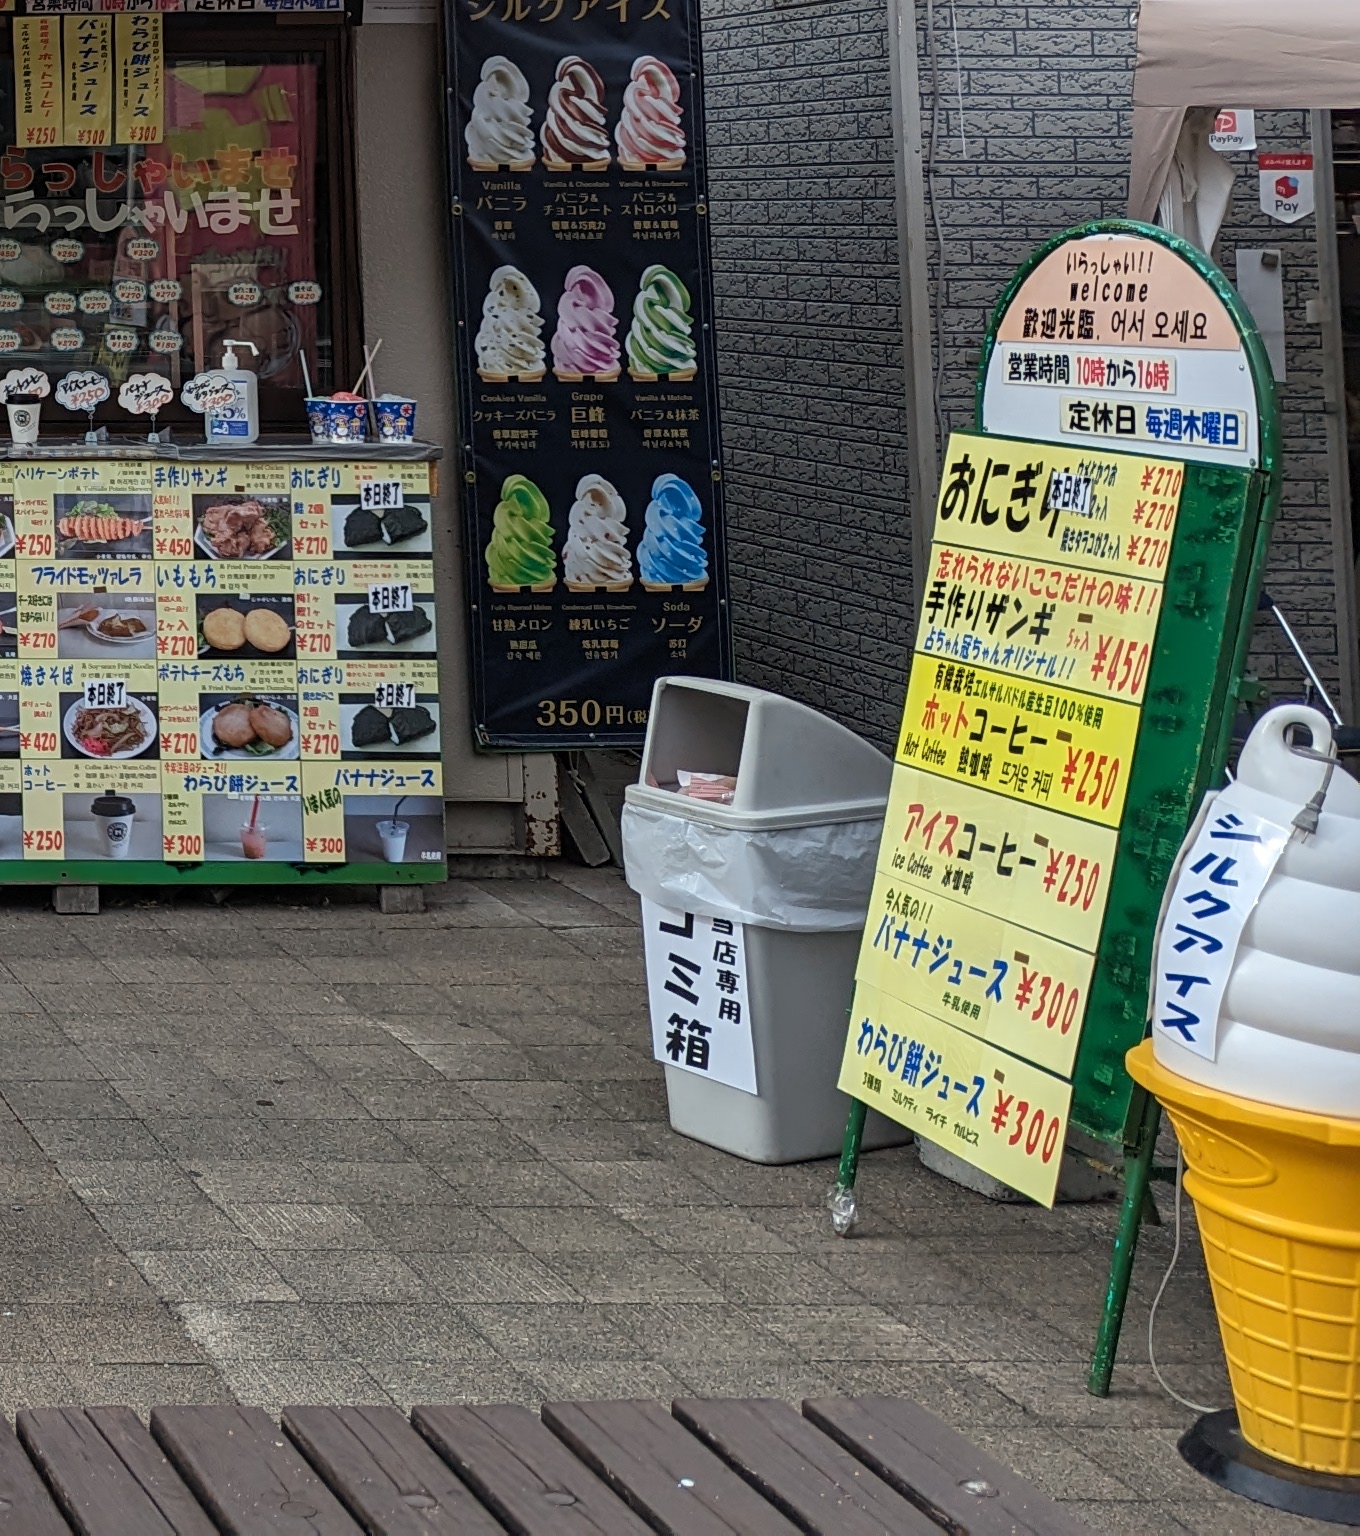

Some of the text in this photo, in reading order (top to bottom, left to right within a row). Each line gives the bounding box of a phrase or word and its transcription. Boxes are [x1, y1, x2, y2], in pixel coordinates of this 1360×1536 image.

[77, 19, 98, 116] バナナジュース
[131, 15, 151, 117] わらび餅ジュース
[1211, 135, 1244, 145] PayPay
[482, 181, 522, 191] Vanilla
[477, 196, 528, 212] バニラ
[543, 204, 612, 216] チョコレート
[620, 204, 690, 216] ストロベリー
[1275, 199, 1299, 214] Pay
[1066, 251, 1153, 275] いらっしゃい!!
[1070, 275, 1148, 303] welcome
[1111, 309, 1208, 343] 어서 오세요
[1008, 352, 1170, 391] 営業時間 10時から16時
[571, 392, 604, 403] Grape
[473, 410, 557, 423] クッキーズバニラ
[571, 406, 607, 424] 巨峰
[1068, 401, 1239, 445] 定休日 毎週木曜日
[14, 467, 100, 481] ハリケーンポテト
[290, 466, 341, 489] おにぎり
[1140, 465, 1181, 498] ¥270
[1133, 499, 1175, 532] ¥270
[15, 534, 52, 556] ¥250
[155, 537, 192, 556] ¥450
[1126, 535, 1168, 568] ¥270
[31, 567, 142, 585] フライドモッツァレラ
[156, 564, 217, 588] いももち
[935, 549, 1158, 615] 忘れられないここだけの味!!
[663, 601, 691, 612] Soda
[925, 580, 1056, 646] 手作りザンギ
[491, 617, 553, 632] 甘熟メロン
[568, 618, 631, 632] 練乳いちご
[652, 616, 703, 633] ソーダ
[157, 635, 195, 656] ¥270
[924, 626, 1076, 680] 占ちゃん冠ちゃんオリジナル!!
[158, 663, 245, 682] ポテトチーズもち
[1065, 628, 1150, 696] 5ヶ入 ¥450
[20, 664, 74, 686] 焼きそば
[87, 682, 125, 707] 本日終了
[20, 732, 57, 752] ¥420
[160, 732, 198, 754] ¥270
[903, 732, 947, 766] Hot Coffee
[921, 692, 1120, 810] ホットコーヒー ¥250
[23, 764, 50, 777] ホット
[335, 768, 436, 788] バナナジュース
[999, 761, 1054, 802] 뜨거운 커피
[24, 780, 67, 792] コーヒー
[183, 775, 299, 793] わらび餅ジュース
[23, 831, 63, 852] ¥250
[891, 847, 933, 880] ice Coffee
[903, 803, 1100, 912] アイスコーヒー ¥250
[885, 887, 934, 924] 今人気の!!
[1160, 813, 1263, 1042] シルクアイス
[873, 914, 1079, 1036] バナナジュース ¥300
[942, 991, 982, 1020] 牛乳使用
[857, 1017, 1060, 1164] わらび餅ジュース ¥300
